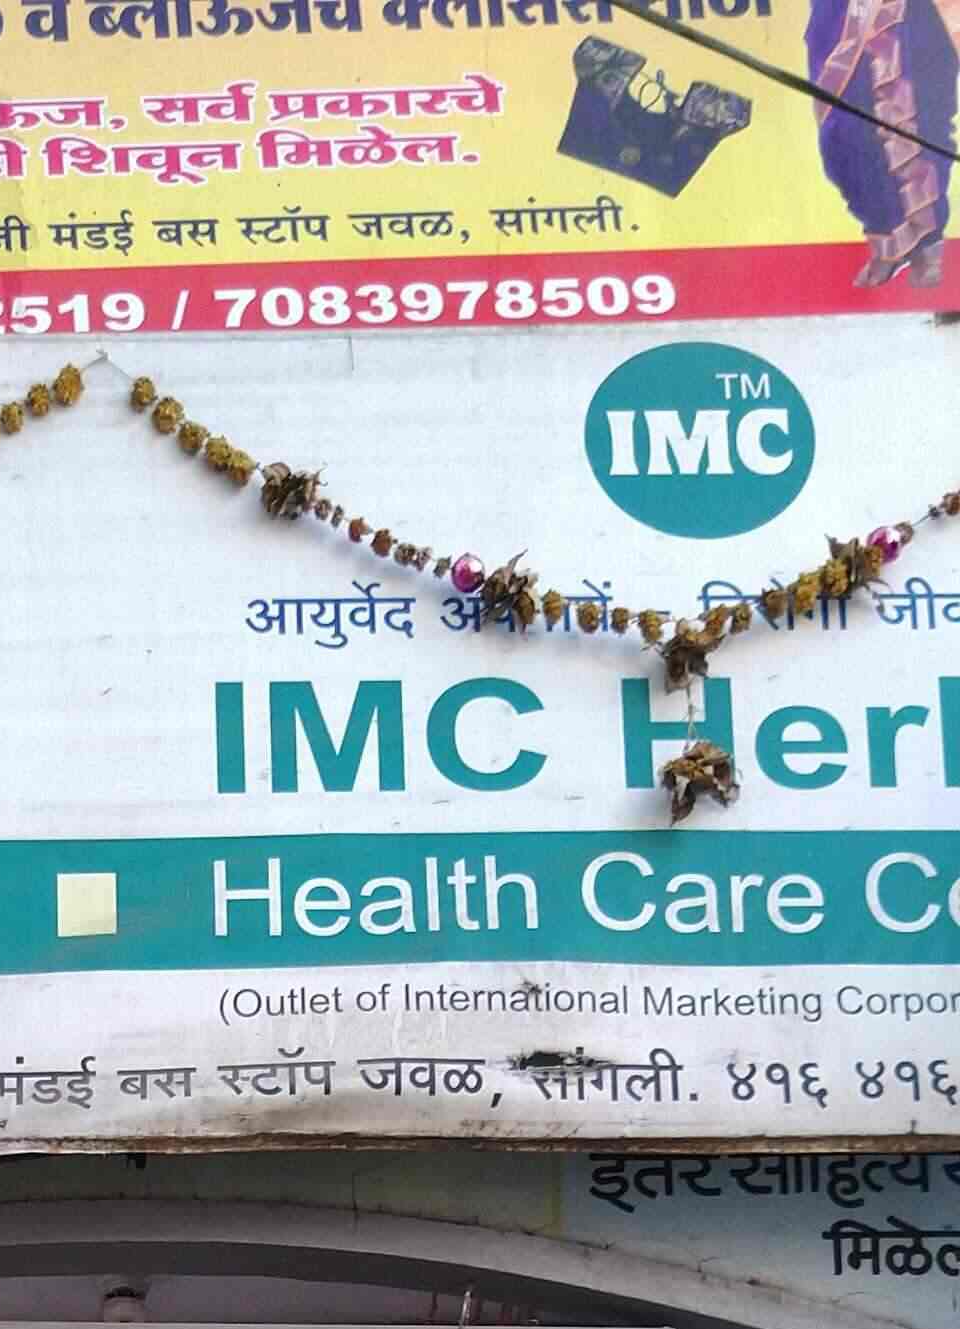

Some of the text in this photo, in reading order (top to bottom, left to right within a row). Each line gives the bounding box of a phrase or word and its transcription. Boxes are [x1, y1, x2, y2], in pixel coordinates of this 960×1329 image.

[143, 83, 255, 125] सर्व
[268, 74, 503, 121] प्रकारचे
[42, 136, 242, 184] शिवून
[256, 126, 480, 169] मिळेल.
[48, 208, 137, 256] मंडई
[153, 217, 218, 248] बस
[238, 204, 331, 245] स्टॉप
[348, 208, 471, 244] जवळ,
[489, 195, 640, 234] सांगली.
[213, 273, 677, 330] 7083978509
[716, 373, 772, 400] TM
[605, 407, 795, 477] IMC
[245, 580, 416, 648] आयुर्वेद
[214, 675, 548, 795] IMC
[212, 854, 540, 937] Health
[579, 851, 825, 935] Care
[218, 986, 344, 1026] (Outlet
[356, 984, 392, 1014] of
[403, 983, 630, 1015] International
[642, 984, 824, 1023] Marketing
[116, 1066, 197, 1101] बस
[217, 1047, 337, 1097] स्टॉप
[356, 1057, 502, 1109] जवळ,
[727, 1060, 829, 1109] ४१६
[855, 1058, 958, 1106] ४१६
